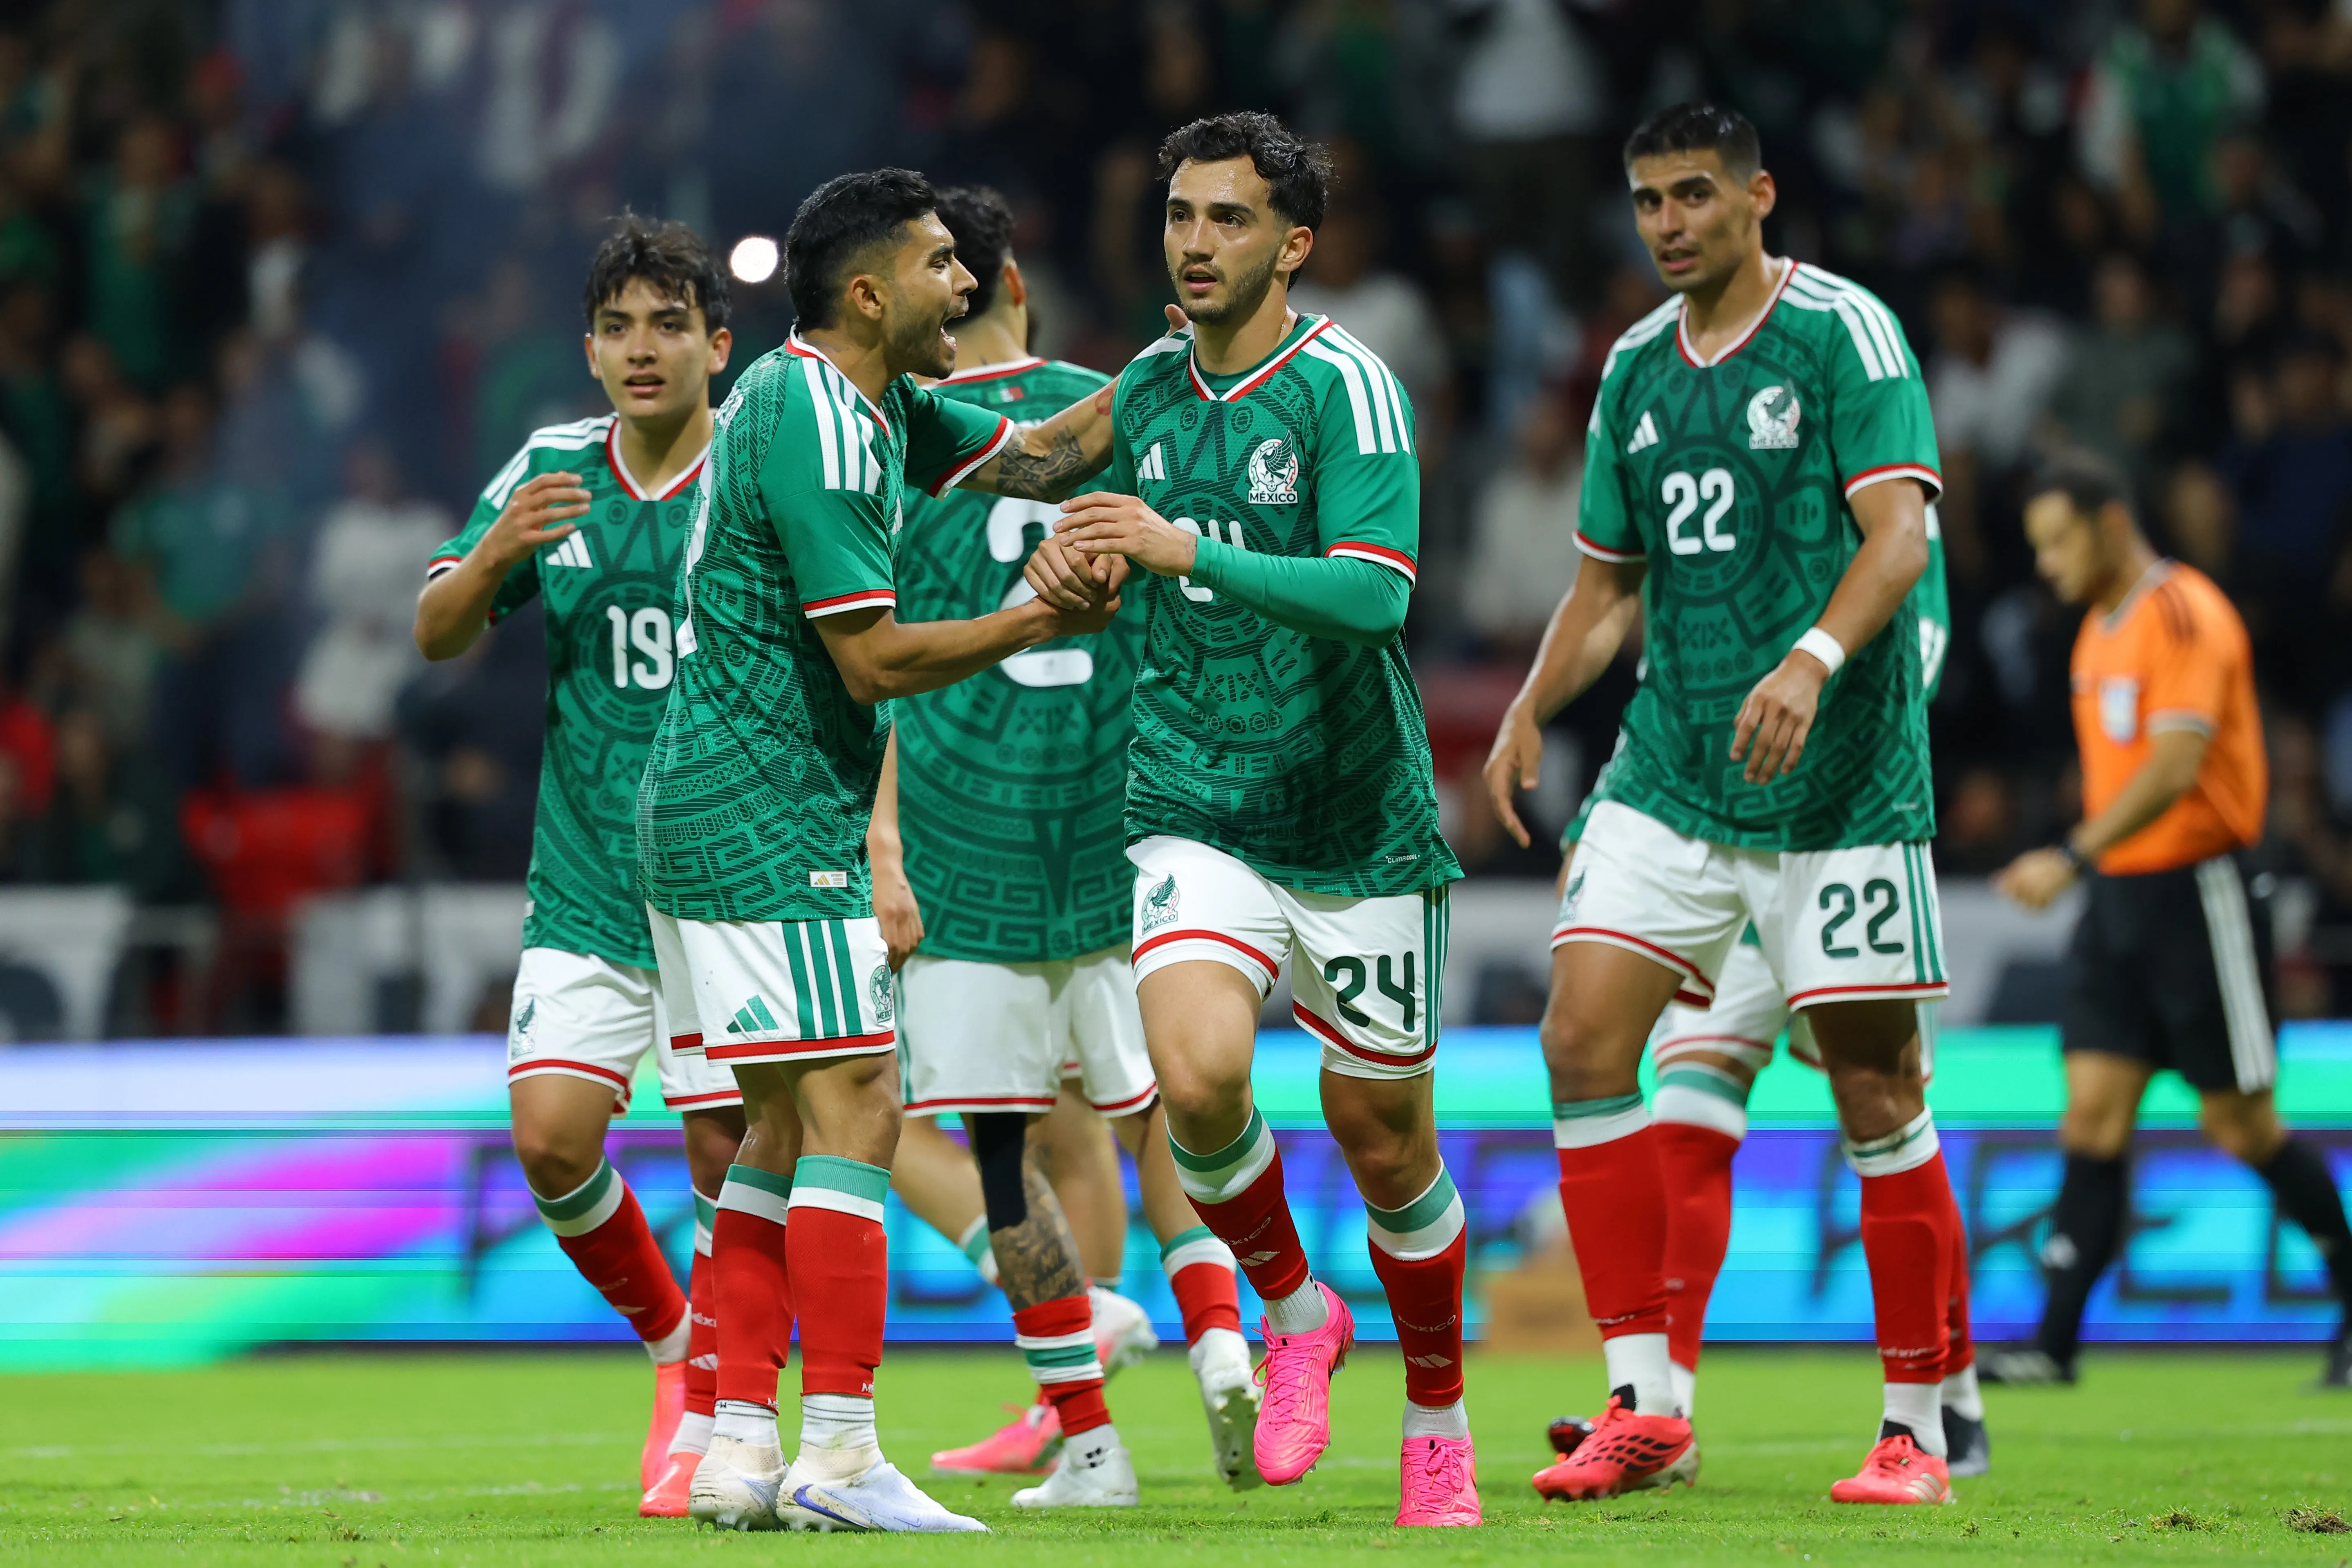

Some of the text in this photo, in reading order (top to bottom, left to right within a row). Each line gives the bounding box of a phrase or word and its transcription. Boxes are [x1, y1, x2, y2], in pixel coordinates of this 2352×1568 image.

[1250, 491, 1296, 502] MÉXICO
[1662, 468, 1736, 555] 22
[606, 605, 673, 690] 19
[1143, 913, 1176, 933] MÉXICO
[1819, 879, 1904, 958] 22
[1324, 951, 1416, 1032] 24
